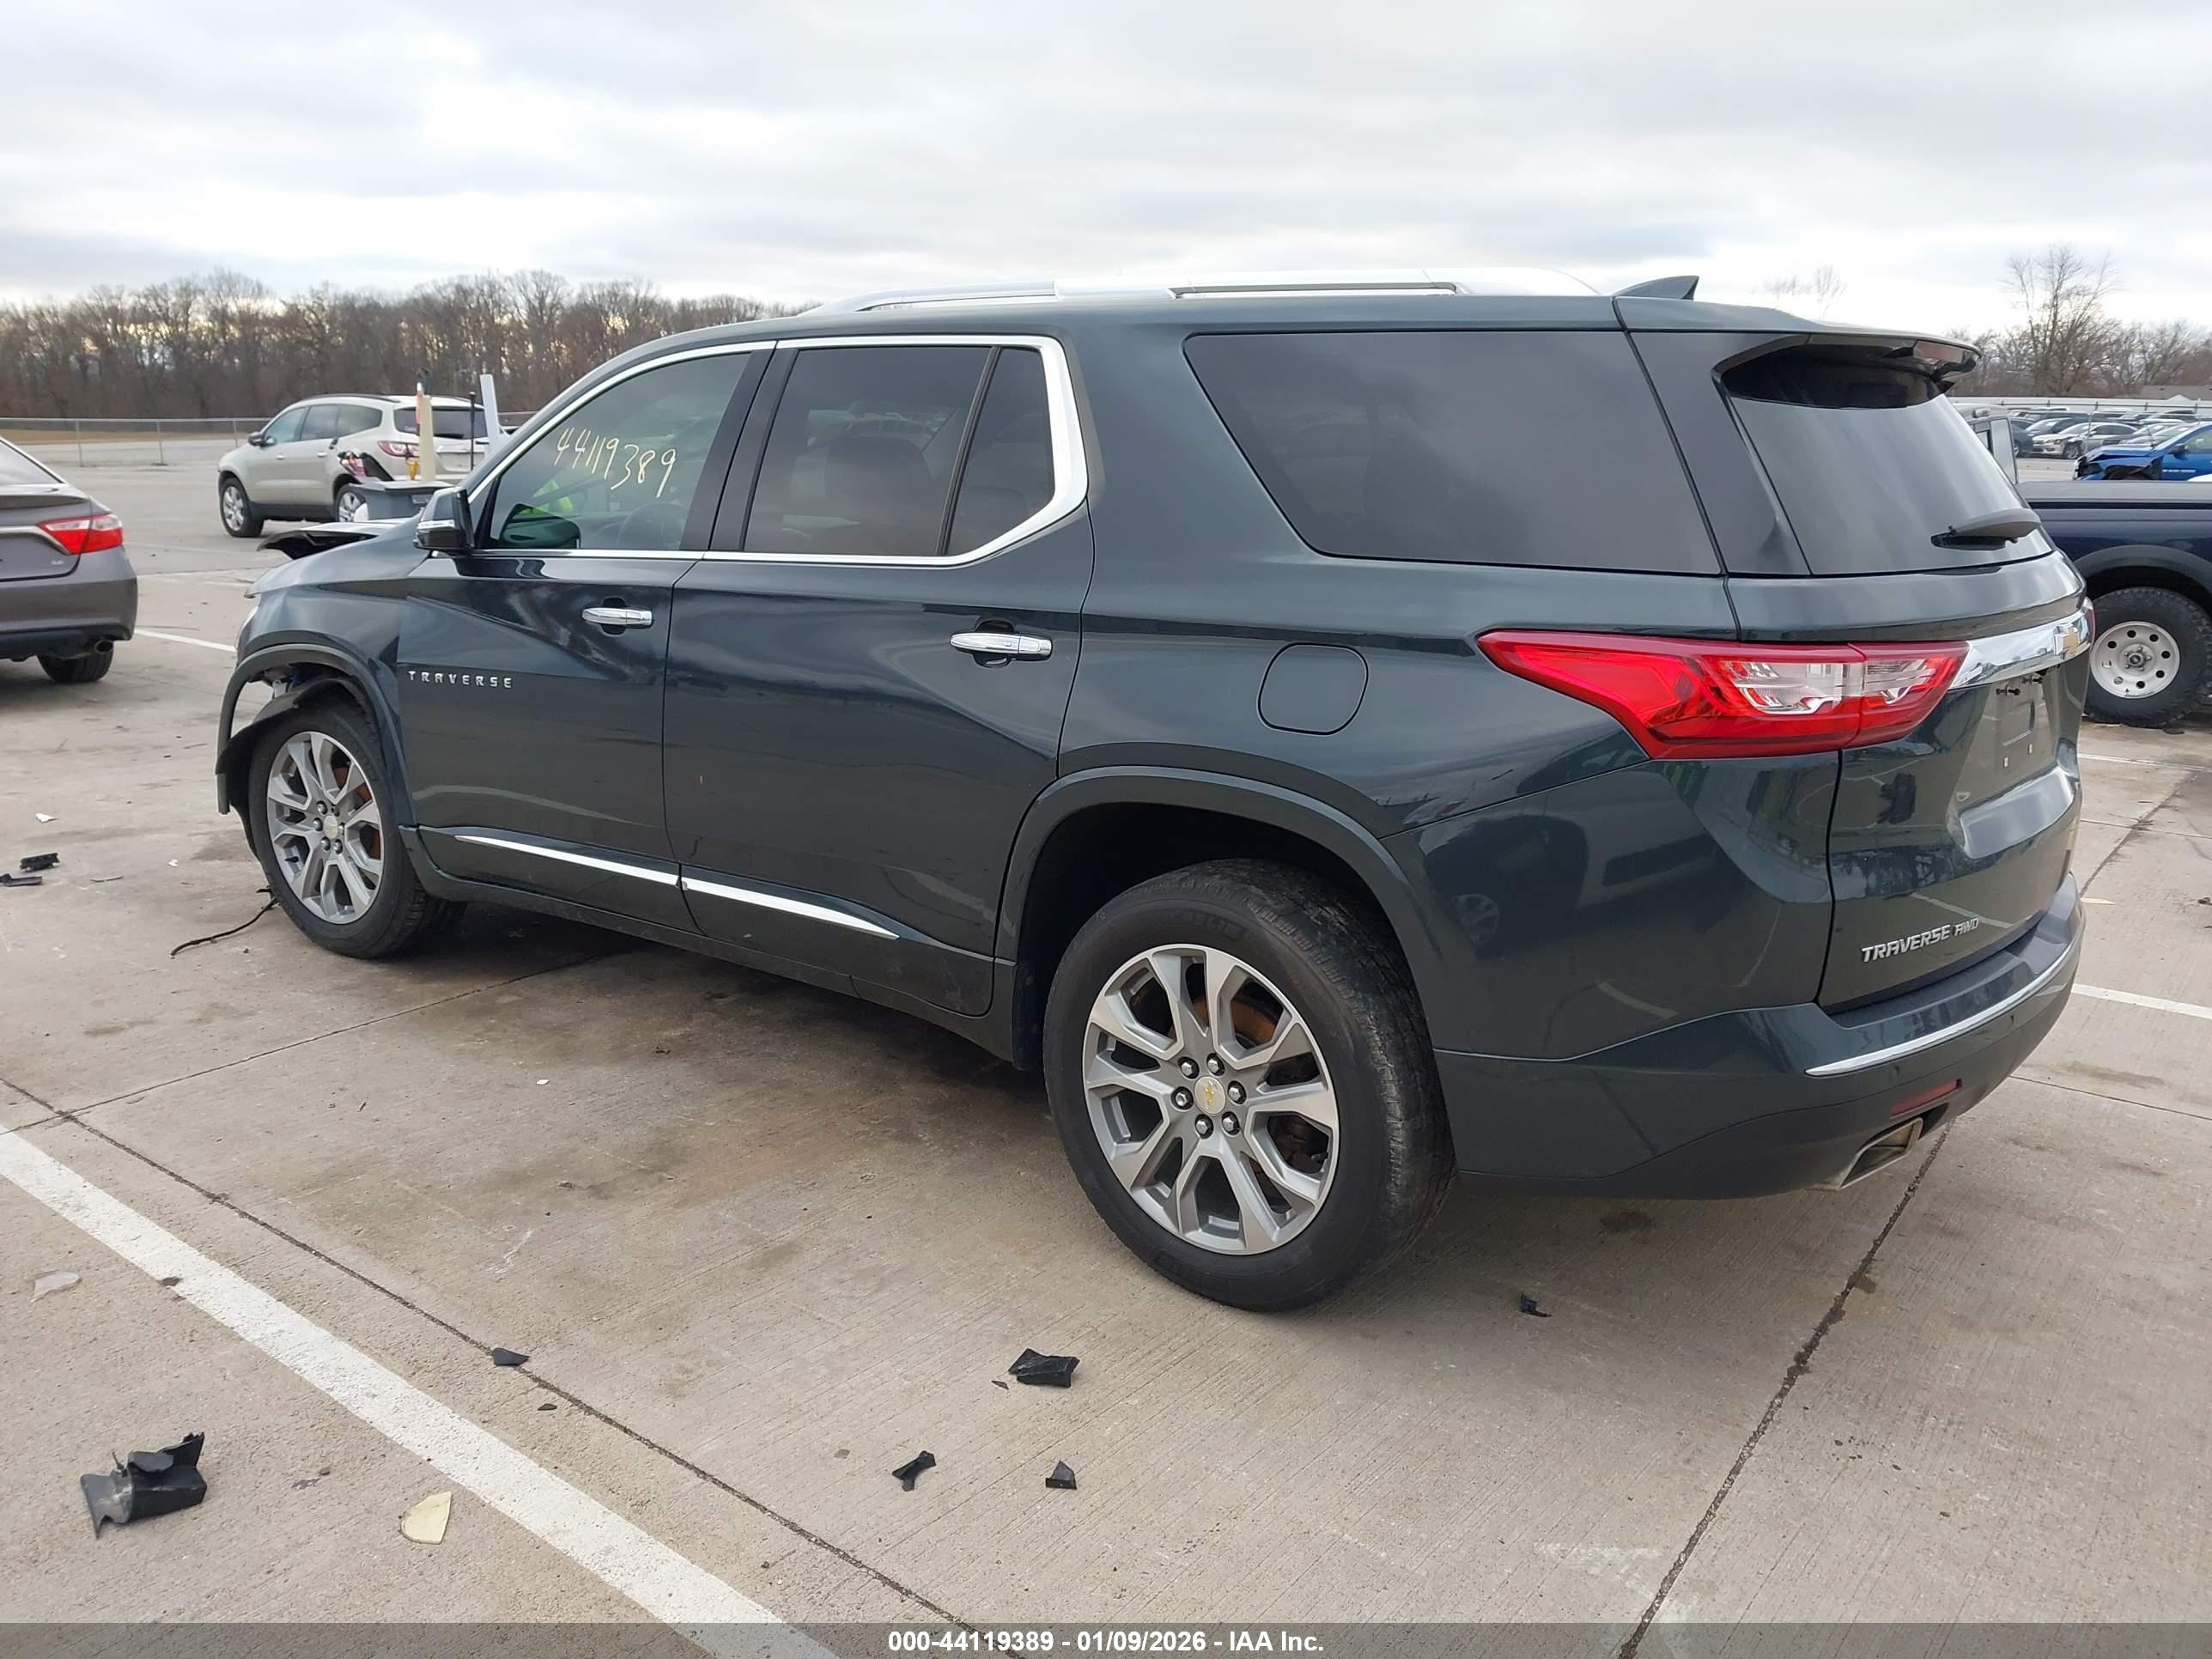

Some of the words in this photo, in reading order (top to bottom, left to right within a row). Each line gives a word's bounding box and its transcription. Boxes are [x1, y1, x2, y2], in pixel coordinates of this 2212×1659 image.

[553, 427, 677, 498] 44119389
[407, 671, 513, 689] TRAVERSE
[1861, 924, 1952, 963] TRAVERSE
[1954, 917, 1979, 937] AWD
